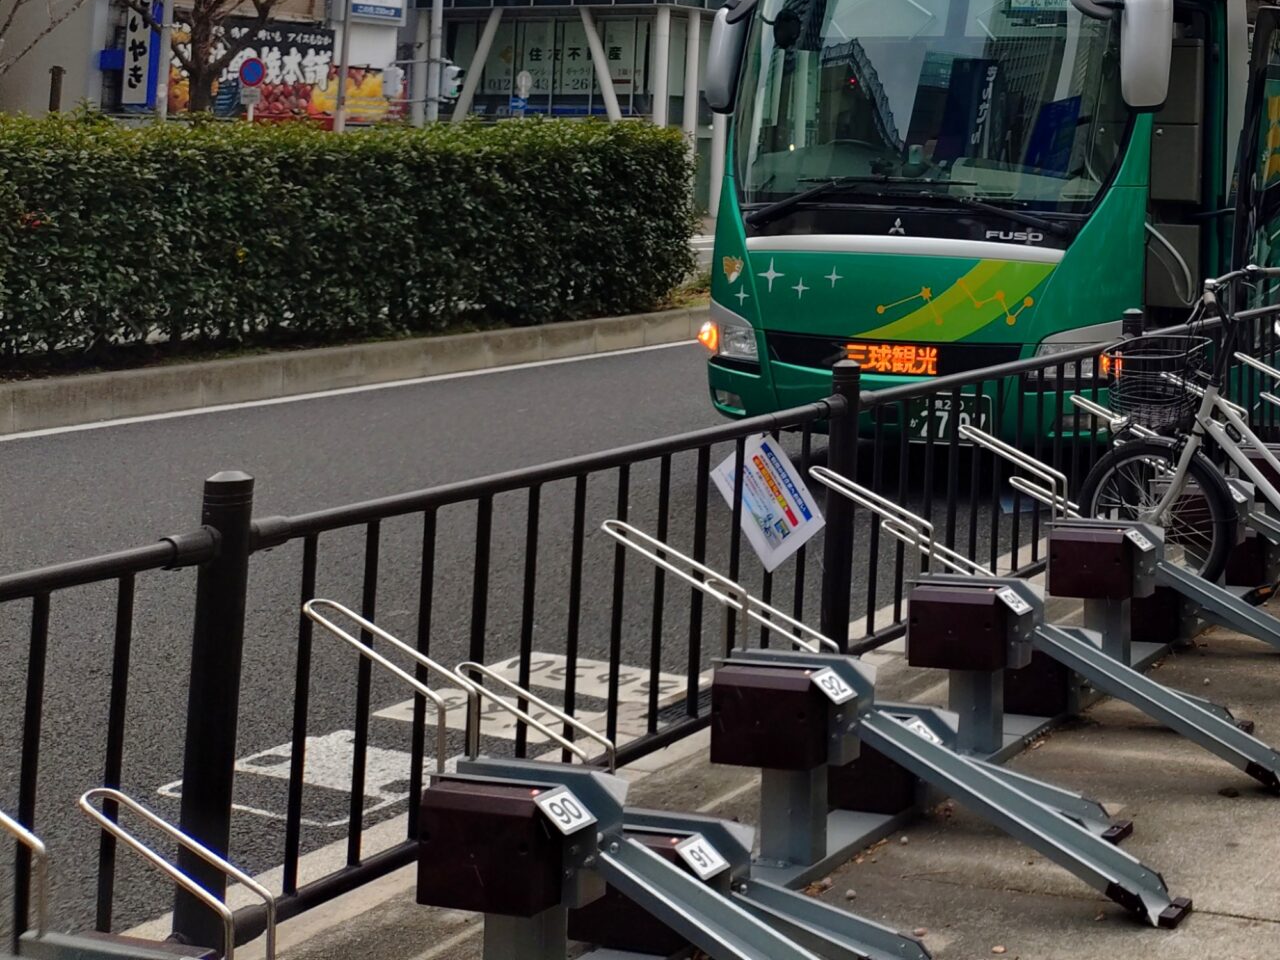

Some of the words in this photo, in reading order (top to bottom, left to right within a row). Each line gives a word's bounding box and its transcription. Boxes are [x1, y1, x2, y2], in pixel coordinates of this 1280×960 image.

[528, 47, 623, 61] 住友不産
[985, 230, 1044, 242] FUSO
[846, 344, 937, 375] 三球観光
[821, 675, 849, 697] 92
[549, 797, 583, 825] 90
[690, 845, 715, 869] 91
